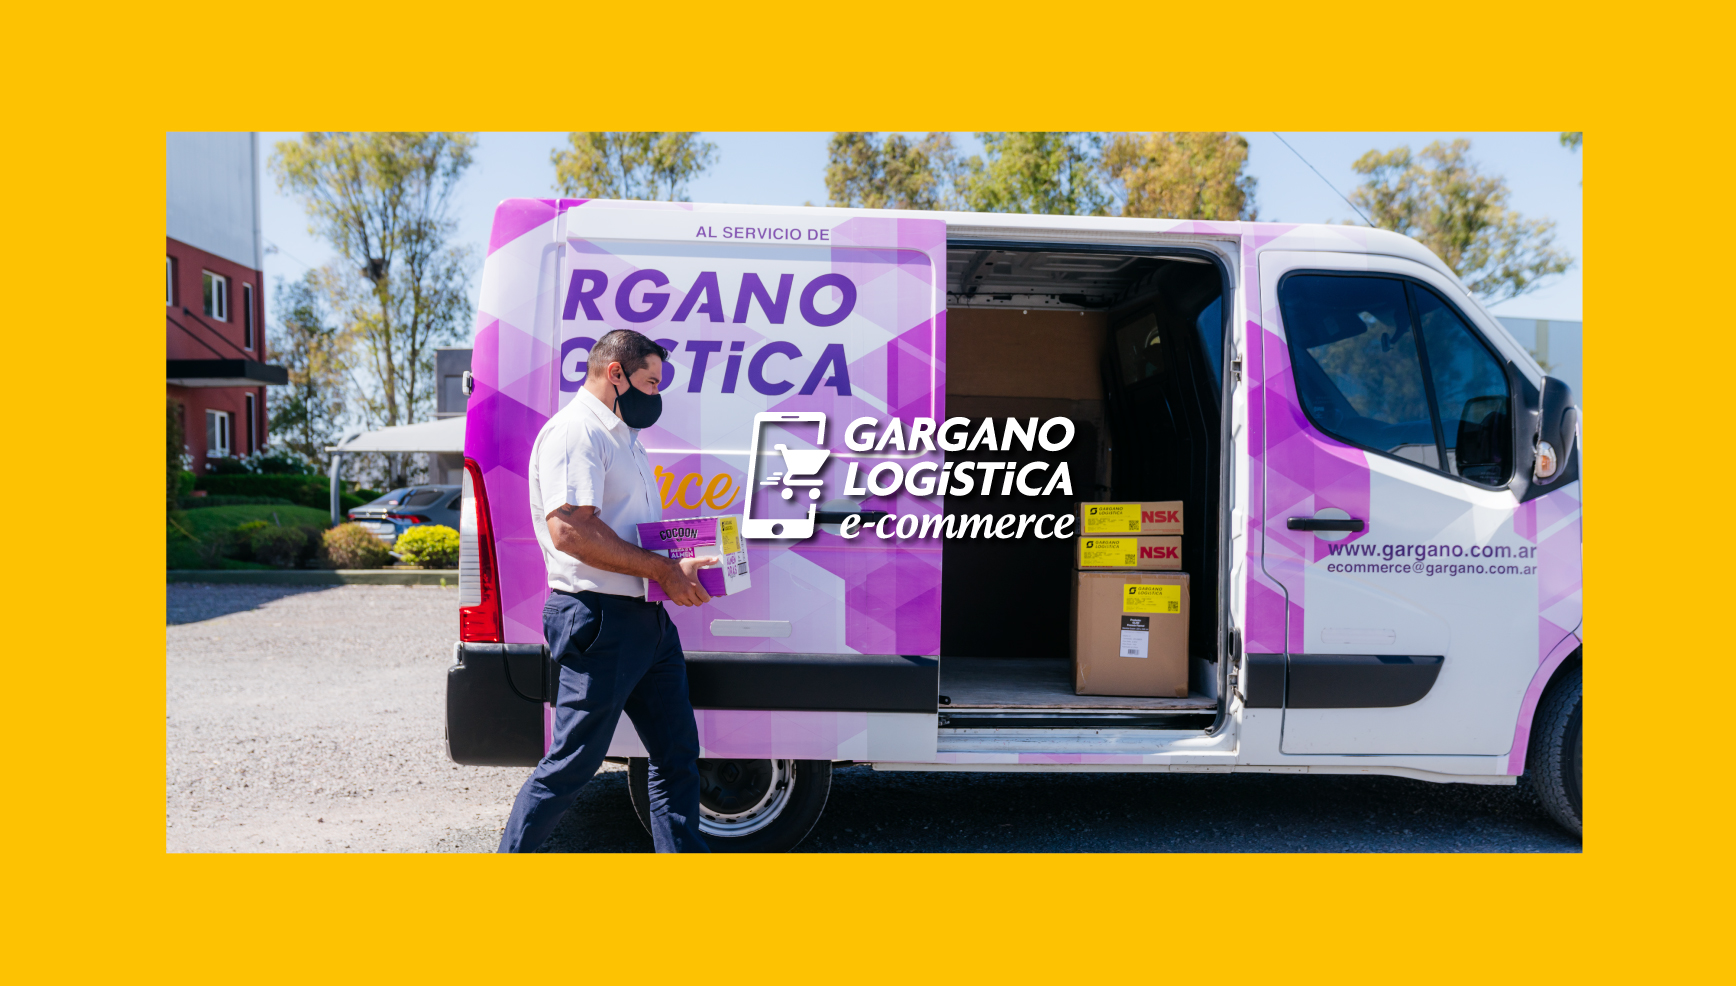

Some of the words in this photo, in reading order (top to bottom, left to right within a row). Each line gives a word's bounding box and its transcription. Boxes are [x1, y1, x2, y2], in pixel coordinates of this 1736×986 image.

[696, 226, 717, 238] AL
[723, 226, 802, 241] SERVICIO
[807, 228, 830, 241] DE
[562, 268, 858, 327] RGANO
[1141, 510, 1180, 523] NSK
[659, 527, 699, 542] COCOON
[1140, 546, 1179, 559] NSK
[1328, 543, 1538, 561] www.gargano.com.ar
[1327, 561, 1538, 577] ecommerce@gargano.com.ar
